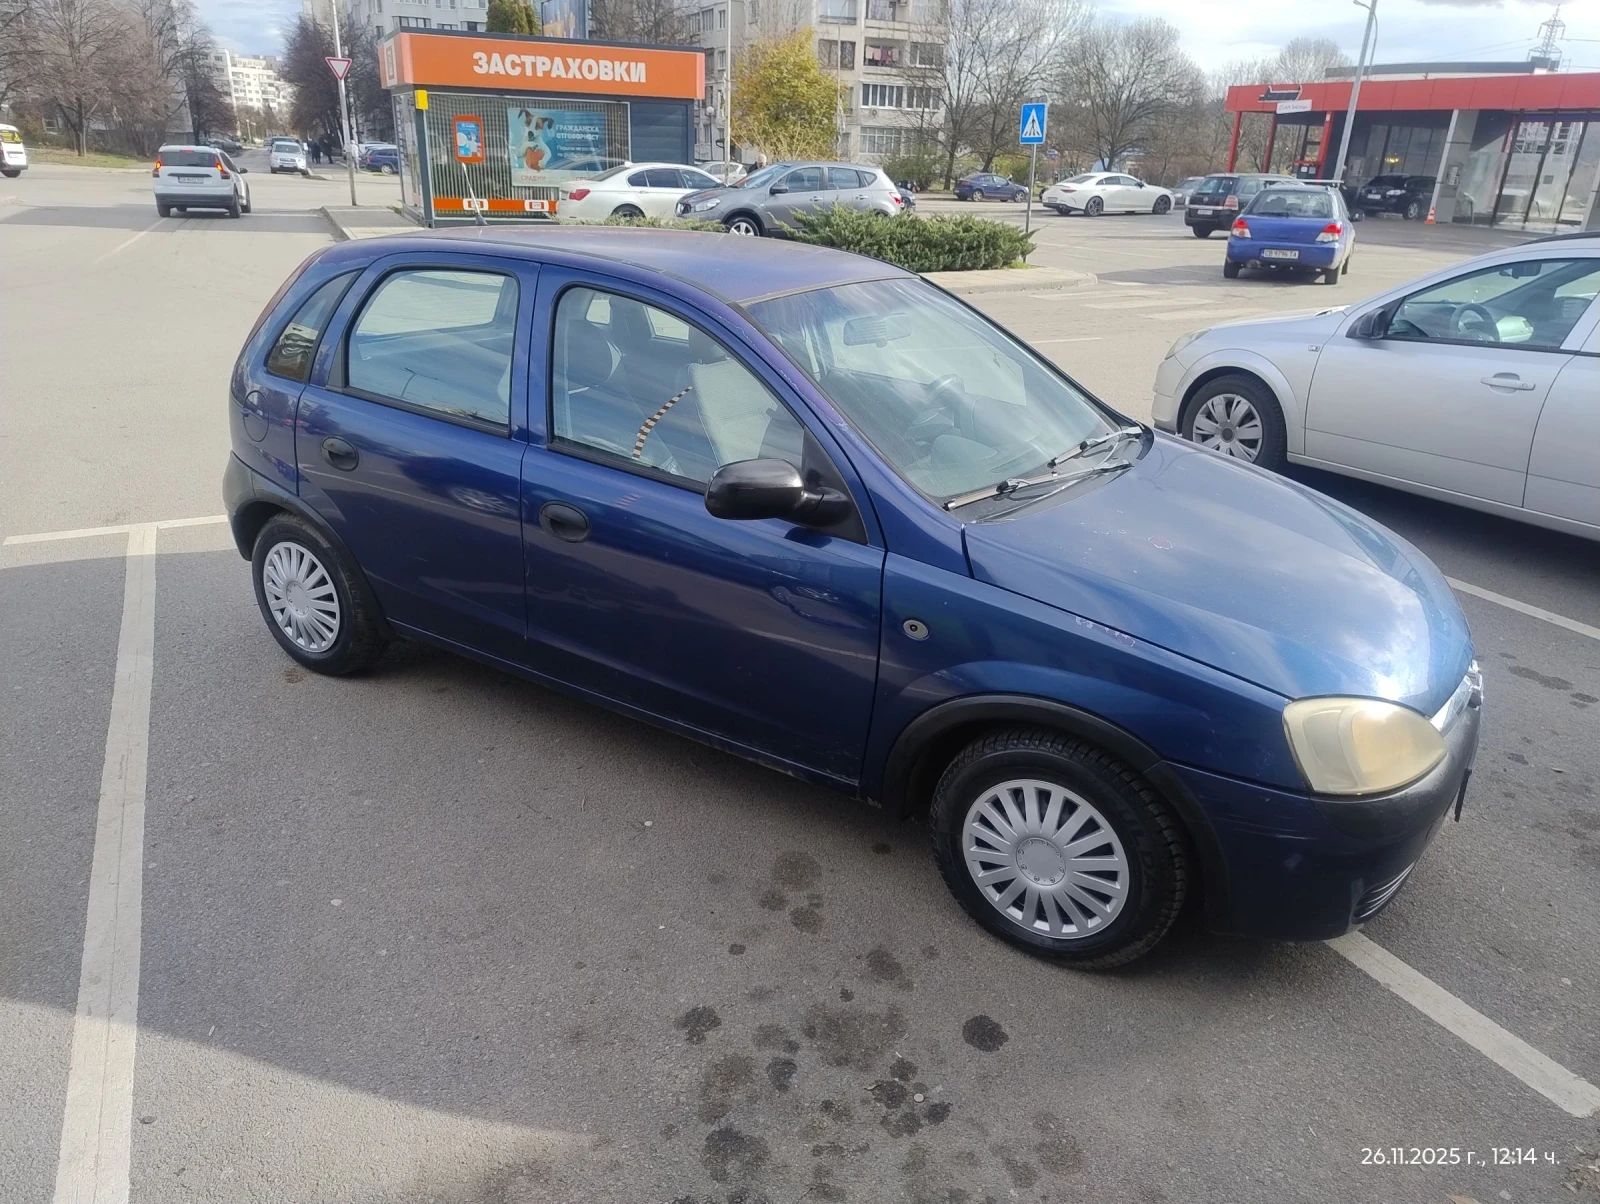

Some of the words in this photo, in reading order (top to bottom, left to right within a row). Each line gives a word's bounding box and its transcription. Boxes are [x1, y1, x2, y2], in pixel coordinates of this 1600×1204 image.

[472, 51, 647, 83] ЗАСТРАХОВКИ
[555, 124, 600, 133] ГРАЖДАНСКА
[555, 133, 600, 141] ОТГОВОРНОСТ
